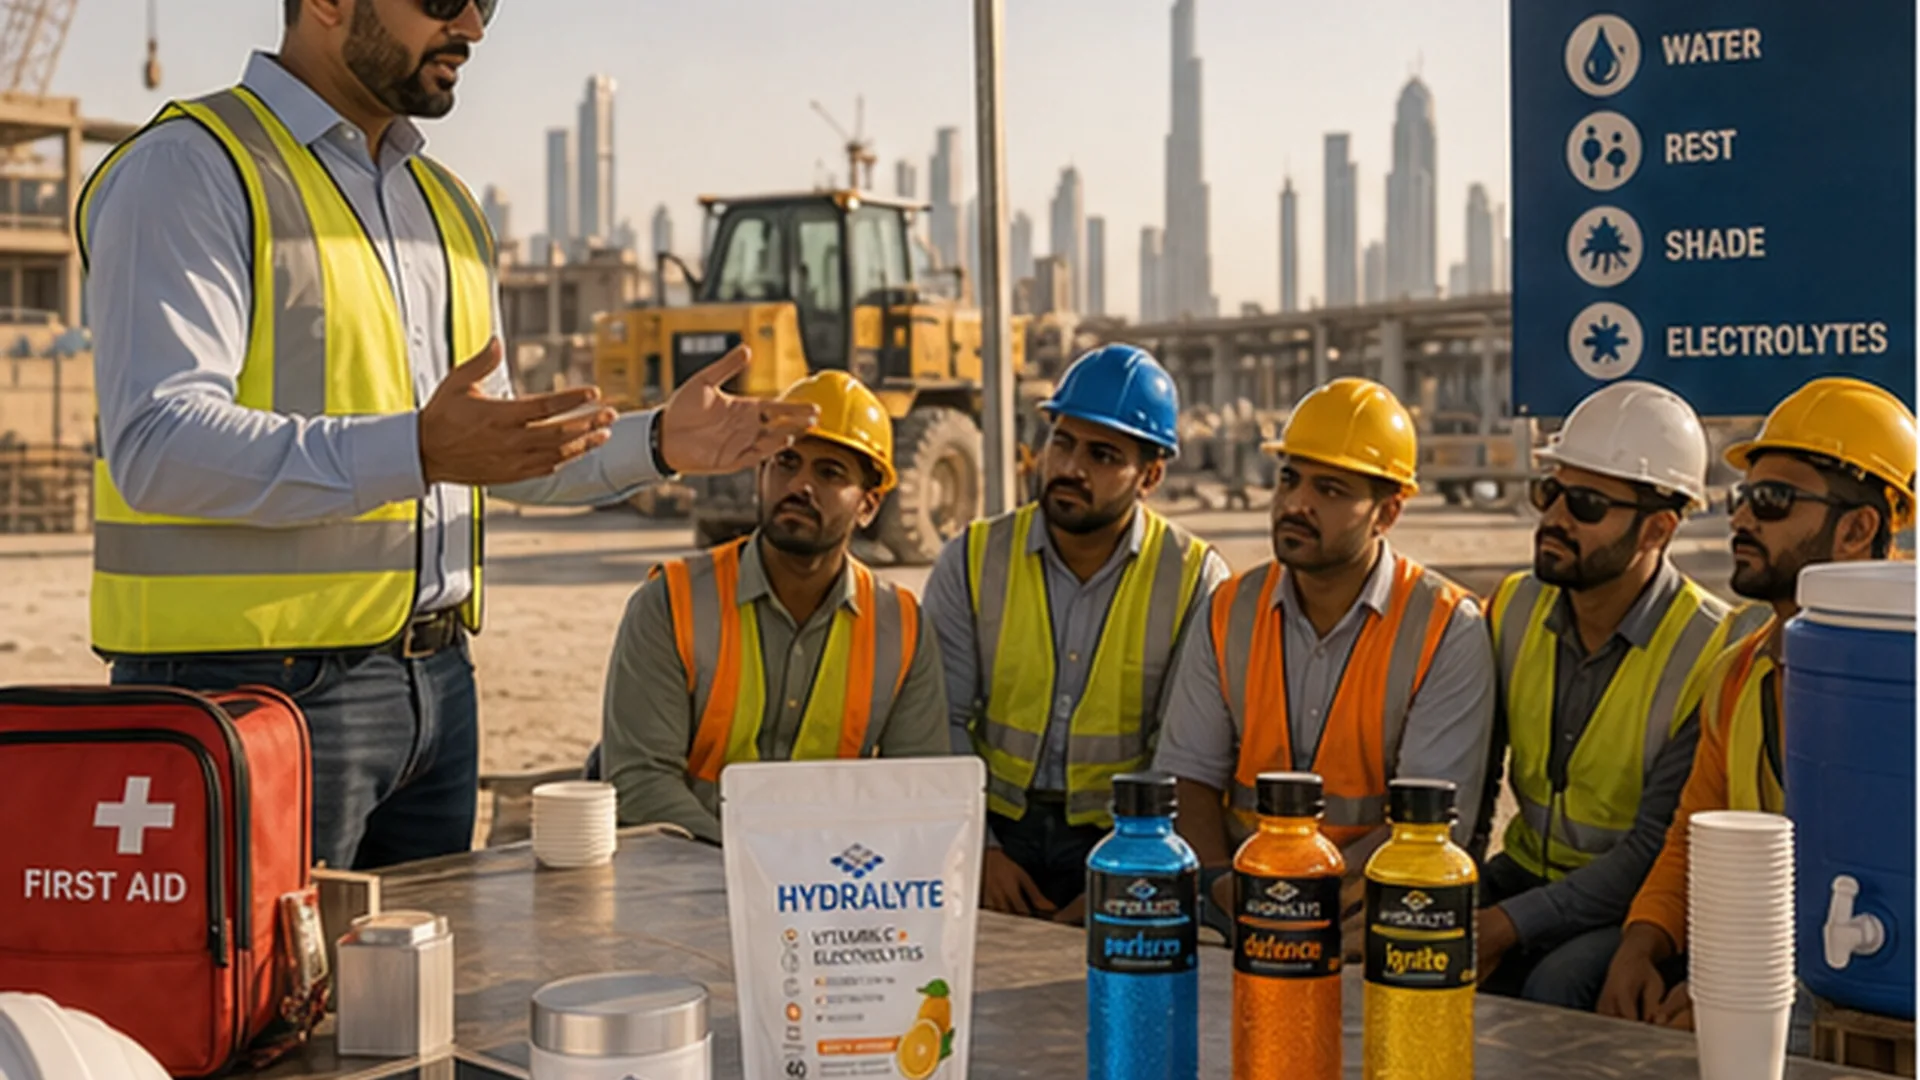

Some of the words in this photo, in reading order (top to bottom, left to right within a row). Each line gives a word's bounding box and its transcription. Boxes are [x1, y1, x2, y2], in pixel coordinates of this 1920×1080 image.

[1662, 28, 1762, 65] WATER
[1664, 129, 1737, 164] REST
[1665, 227, 1765, 262] SHADE
[1666, 322, 1888, 358] ELECTROLYTES
[24, 869, 117, 901] FIRST
[126, 873, 187, 902] AID
[778, 880, 944, 913] HYDRALYTE
